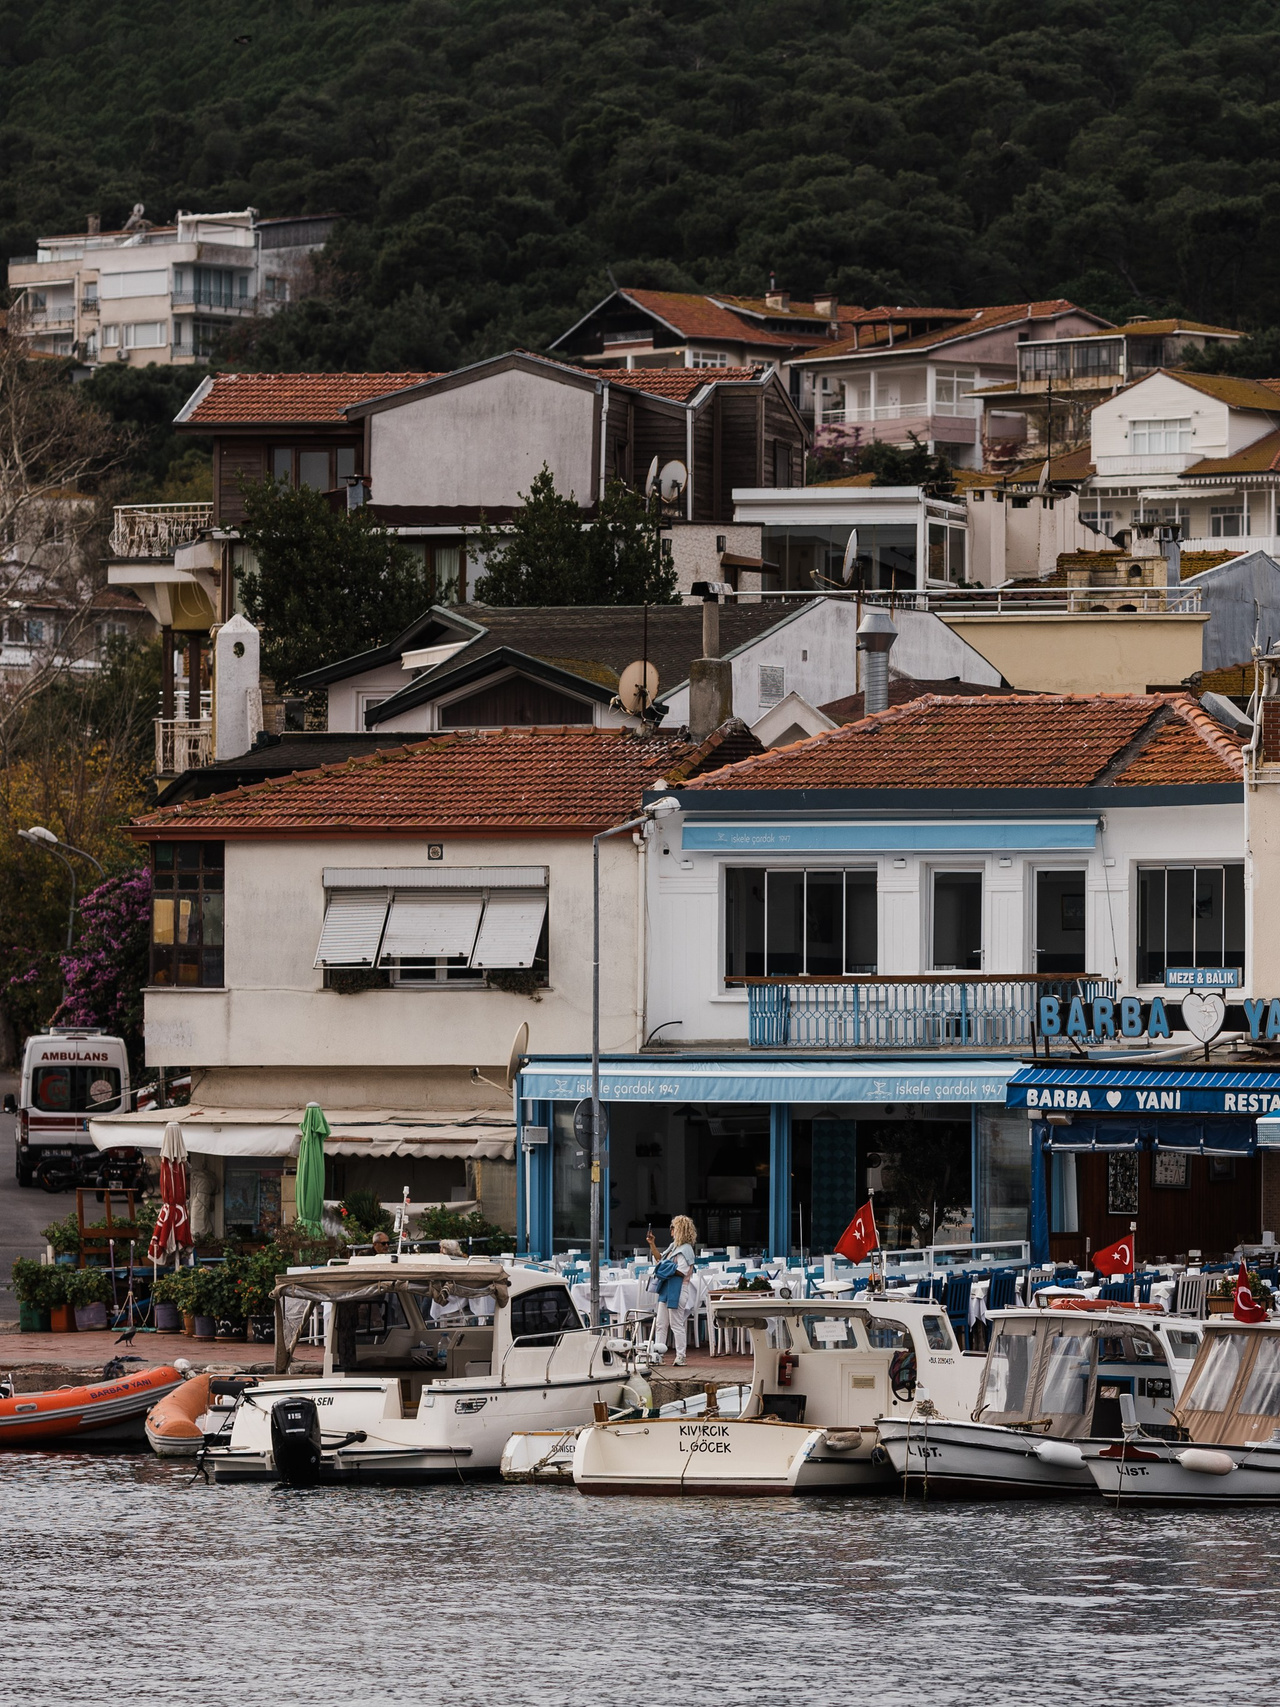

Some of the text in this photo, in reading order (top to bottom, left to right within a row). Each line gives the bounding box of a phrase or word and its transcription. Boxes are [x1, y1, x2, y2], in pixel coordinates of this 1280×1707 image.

[1169, 972, 1195, 984] MEZE
[1197, 972, 1204, 984] &
[1039, 995, 1173, 1039] BARBA
[41, 1052, 109, 1062] AMBULANS
[577, 1080, 680, 1098] iskle çardak 1947
[896, 1081, 1003, 1099] iskele çardak 1947
[1026, 1089, 1092, 1109] BARBA
[1136, 1090, 1181, 1110] YANİ
[89, 1386, 123, 1400] BARBA
[679, 1425, 730, 1437] KIVIRCIK
